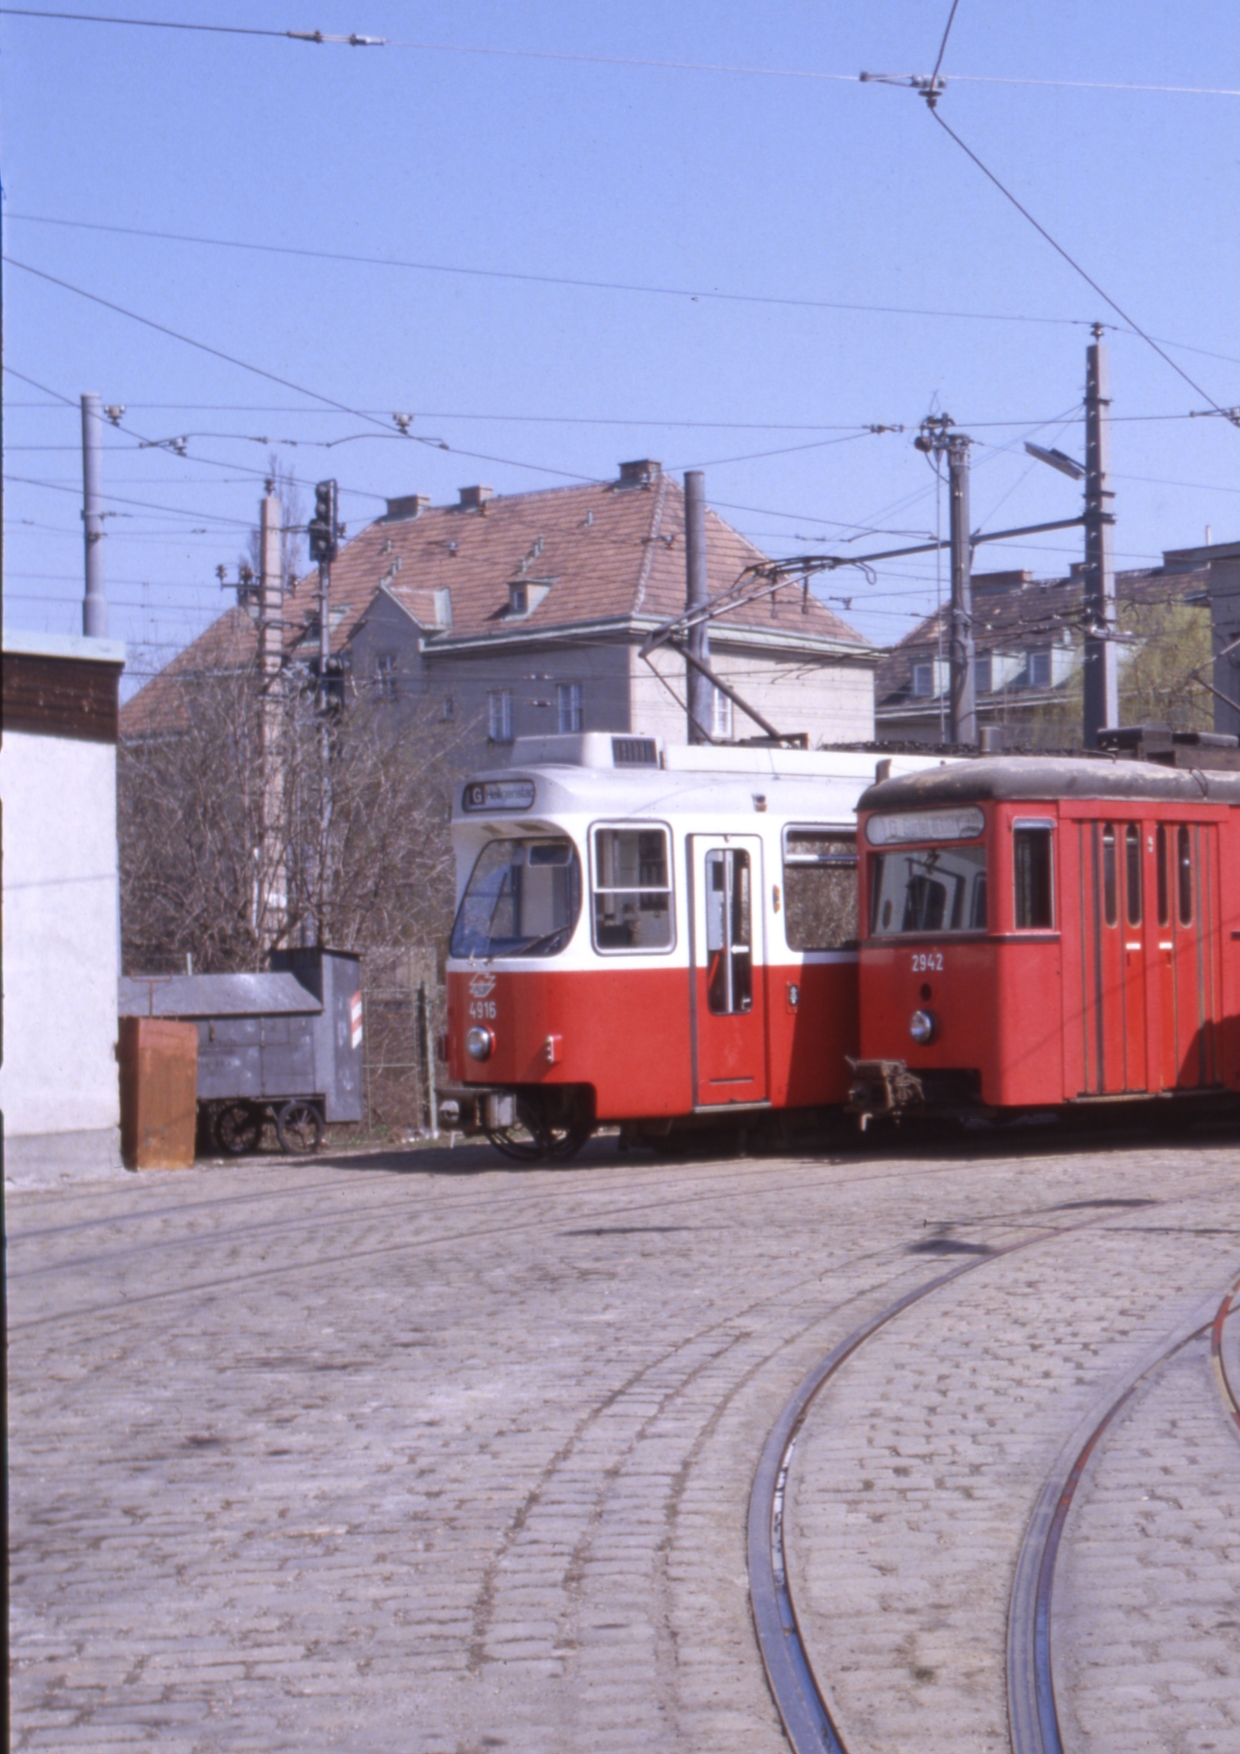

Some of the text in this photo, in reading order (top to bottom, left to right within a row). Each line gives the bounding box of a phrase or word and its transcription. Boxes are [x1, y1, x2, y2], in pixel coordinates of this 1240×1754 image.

[473, 787, 483, 803] G
[912, 953, 943, 971] 2942
[469, 1001, 496, 1019] 4916
